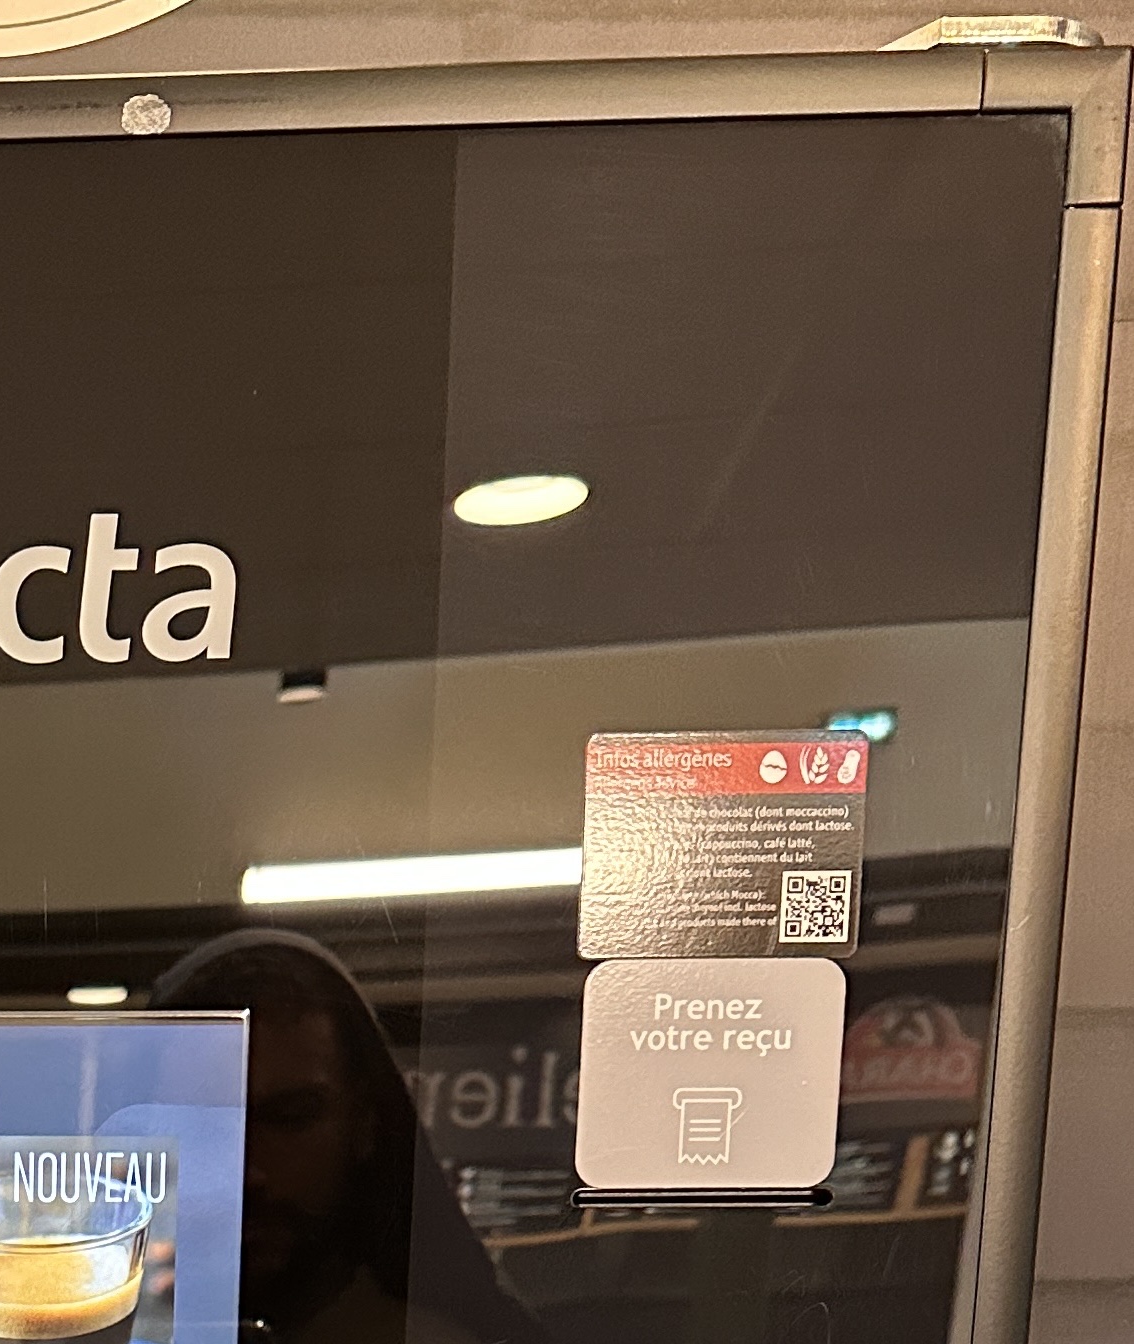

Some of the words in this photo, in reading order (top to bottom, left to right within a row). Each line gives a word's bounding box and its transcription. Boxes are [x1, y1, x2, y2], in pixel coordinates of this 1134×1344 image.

[595, 750, 640, 768] Infos
[643, 748, 732, 772] allergènes
[709, 806, 753, 818] chocolat
[755, 806, 784, 819] (dont
[786, 805, 849, 819] moccaccino)
[750, 820, 788, 832] dérivés
[789, 820, 813, 831] dont
[815, 820, 855, 831] lactose.
[764, 837, 786, 849] café
[787, 837, 816, 850] latté,
[716, 853, 777, 865] contiennent
[779, 852, 794, 863] du
[795, 852, 813, 863] lait
[713, 867, 753, 878] lactose.
[745, 902, 777, 912] lactose
[717, 917, 741, 926] made
[742, 917, 766, 926] there
[767, 916, 777, 926] of
[653, 993, 763, 1021] Prenez
[630, 1027, 714, 1052] votre
[723, 1028, 792, 1057] reçu
[13, 1151, 167, 1204] NOUVEAU
